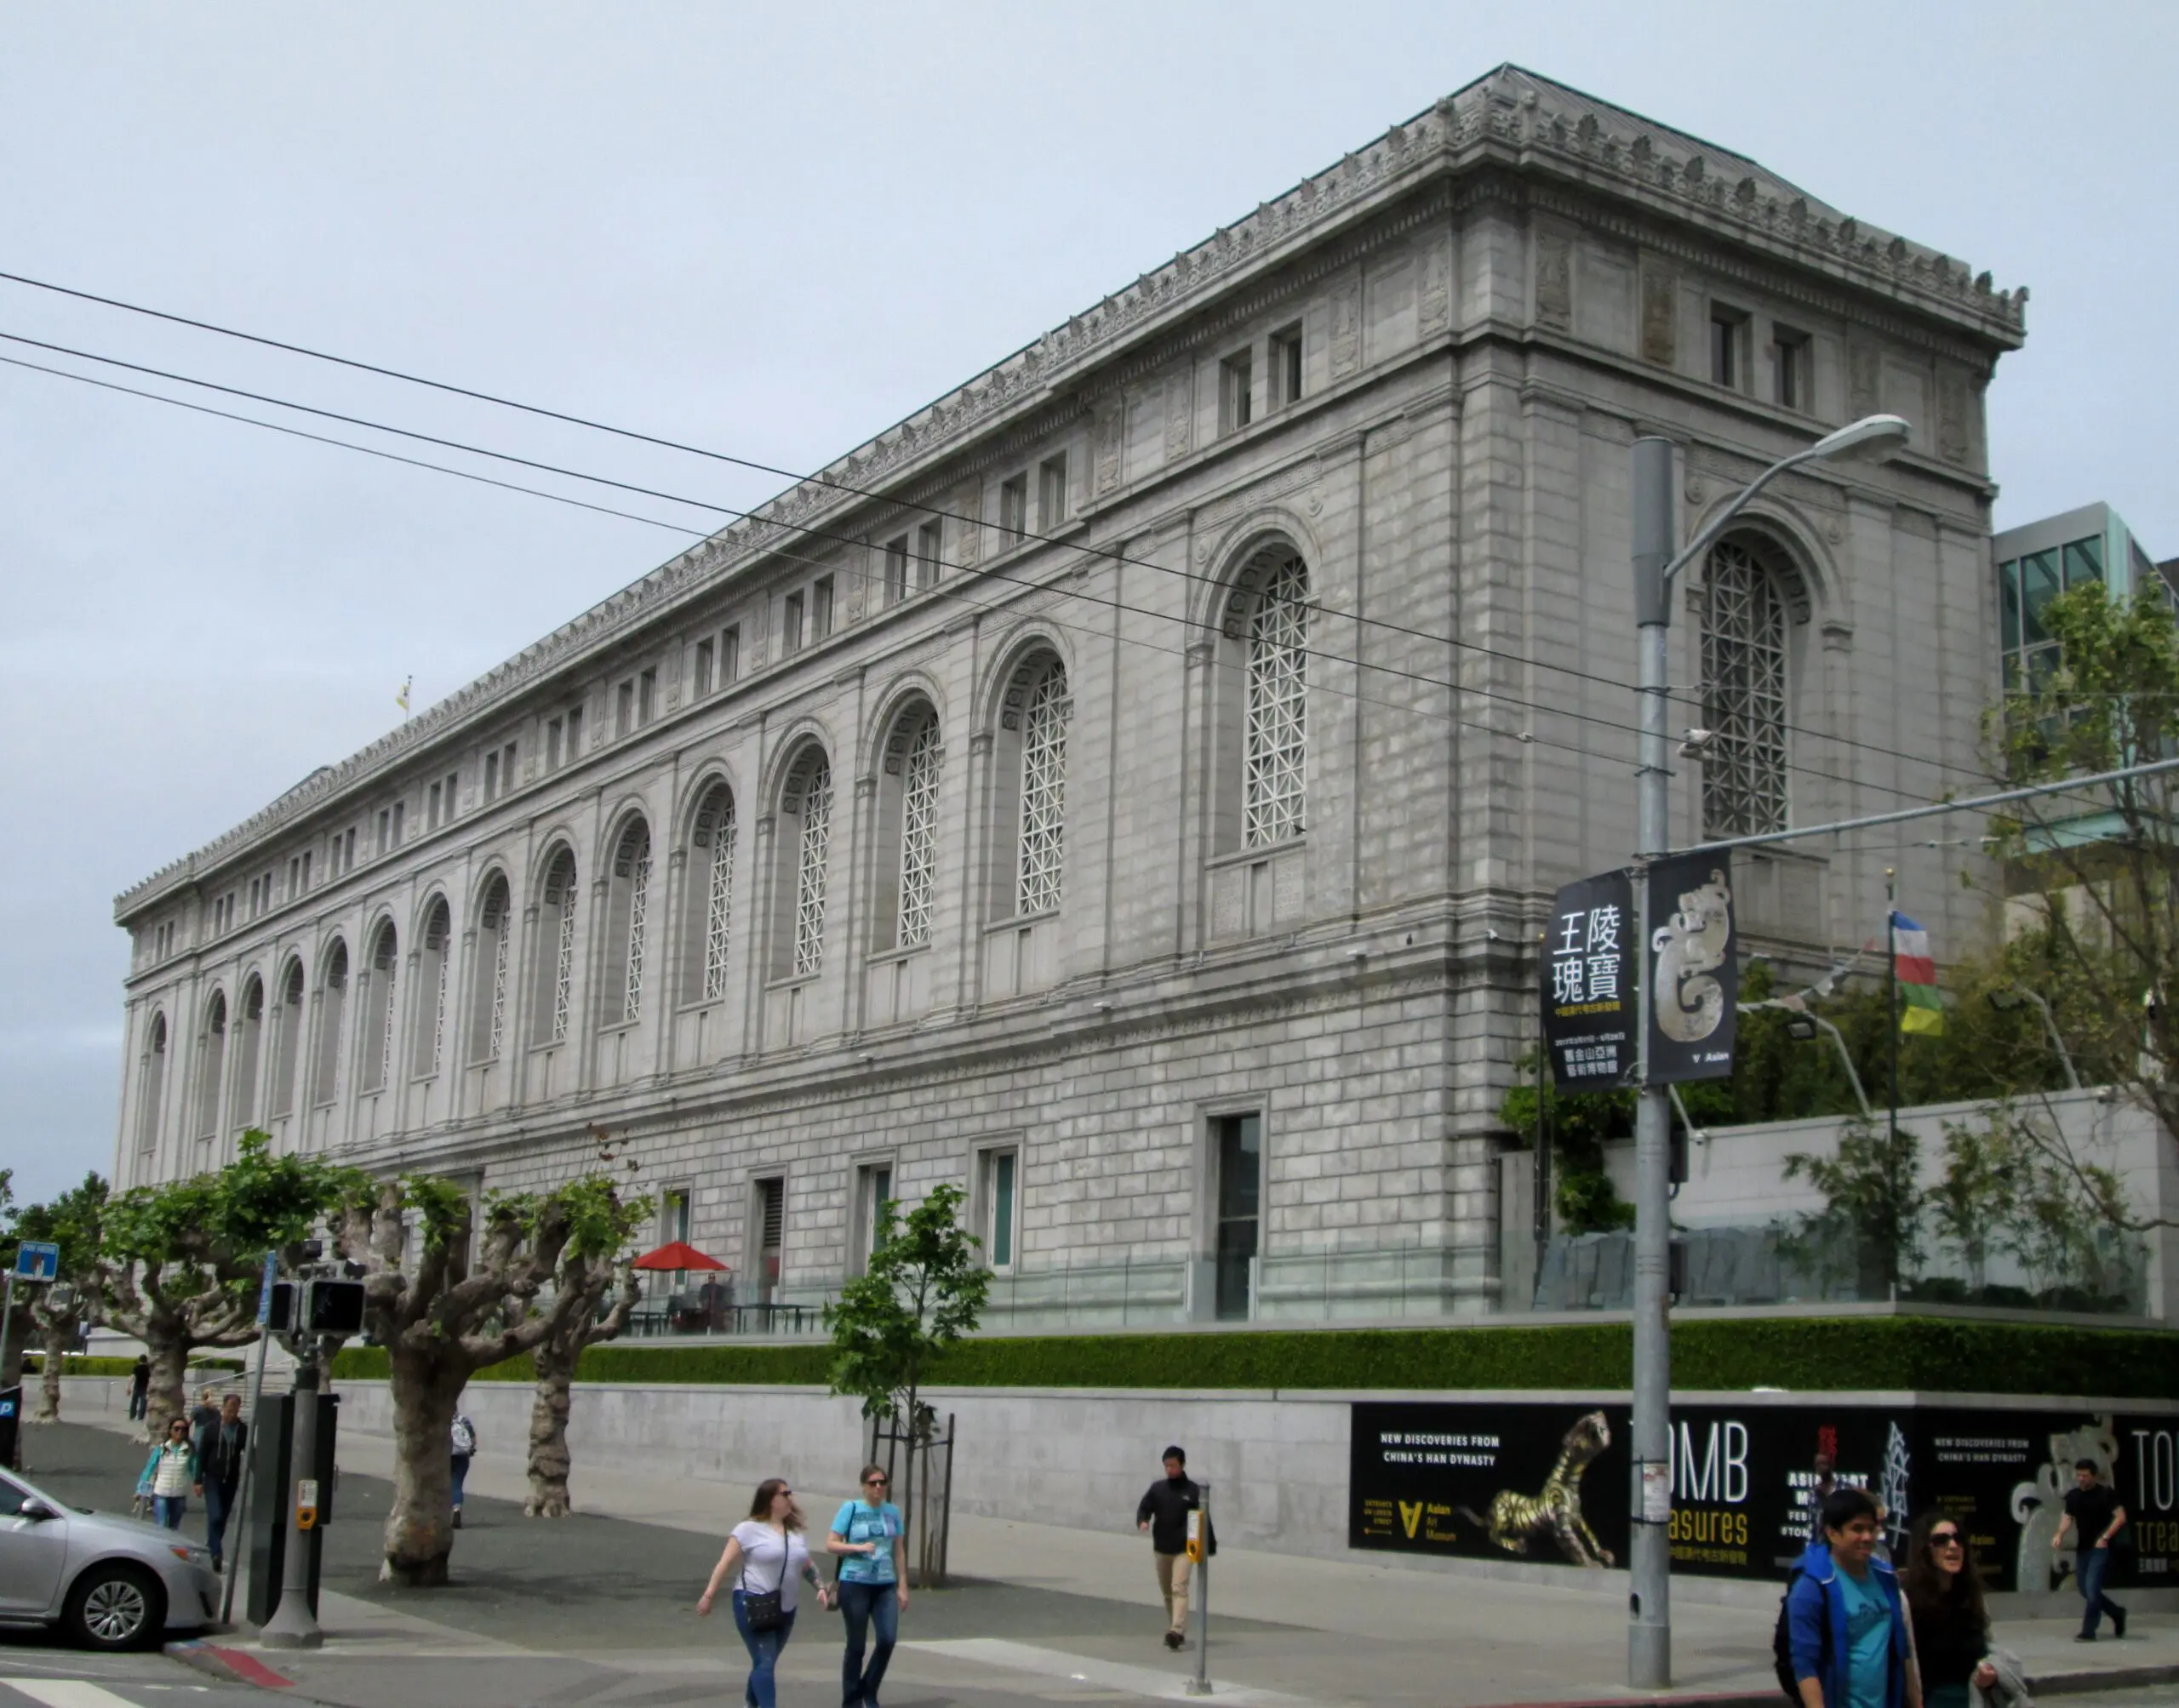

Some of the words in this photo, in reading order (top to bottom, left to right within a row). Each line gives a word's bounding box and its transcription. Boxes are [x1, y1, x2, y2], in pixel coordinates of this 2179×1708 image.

[1553, 904, 1620, 955] 王陵
[1553, 953, 1620, 1003] 瑰寶
[1381, 1432, 1402, 1443] NEW
[1405, 1434, 1467, 1446] DISCOVERIES
[1471, 1436, 1499, 1447] FROM
[1384, 1450, 1423, 1463] CHINA'S
[1427, 1453, 1446, 1464] HAN
[1450, 1453, 1496, 1466] DYNASTY
[1628, 1420, 1748, 1502] MB
[2132, 1431, 2179, 1511] TO
[1668, 1509, 1747, 1545] asures
